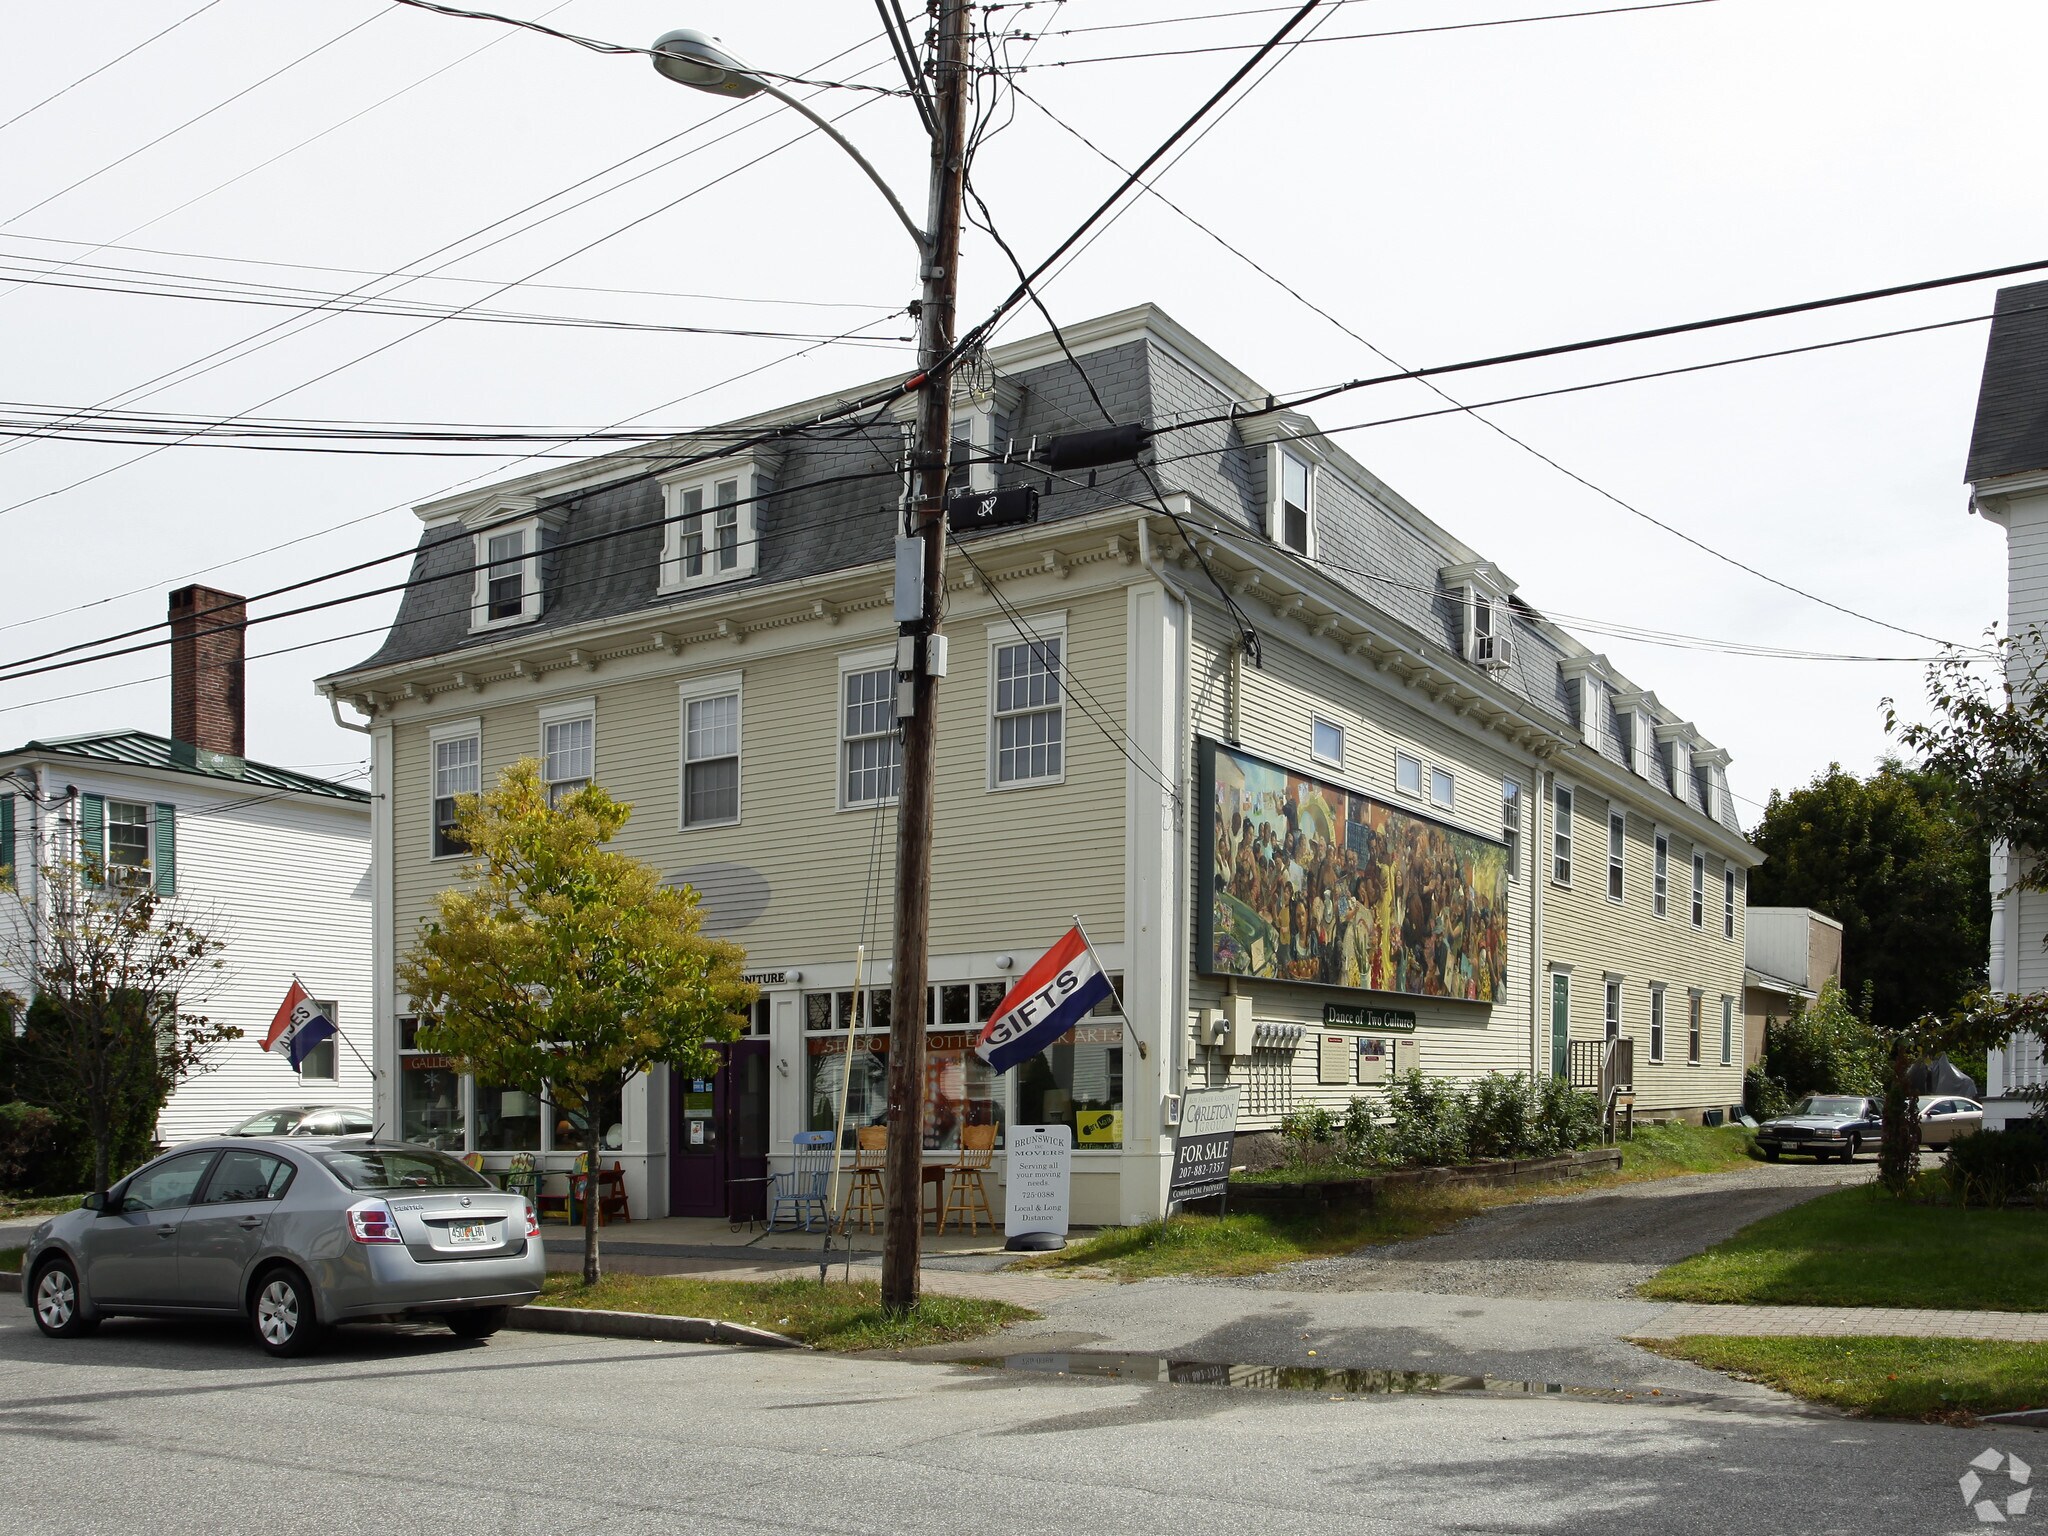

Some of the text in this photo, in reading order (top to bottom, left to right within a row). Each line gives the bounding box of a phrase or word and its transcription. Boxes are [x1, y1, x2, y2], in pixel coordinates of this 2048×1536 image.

[986, 970, 1079, 1045] GIFTS
[1328, 1007, 1414, 1028] Dance of Two Cultures
[1074, 1028, 1122, 1043] ARTS
[411, 1056, 457, 1069] GALLER
[1200, 1120, 1226, 1132] GROUP
[1015, 1135, 1064, 1148] BRUNSWICK
[1180, 1141, 1229, 1163] FOR SALE
[1179, 1162, 1224, 1178] 207-882-7357
